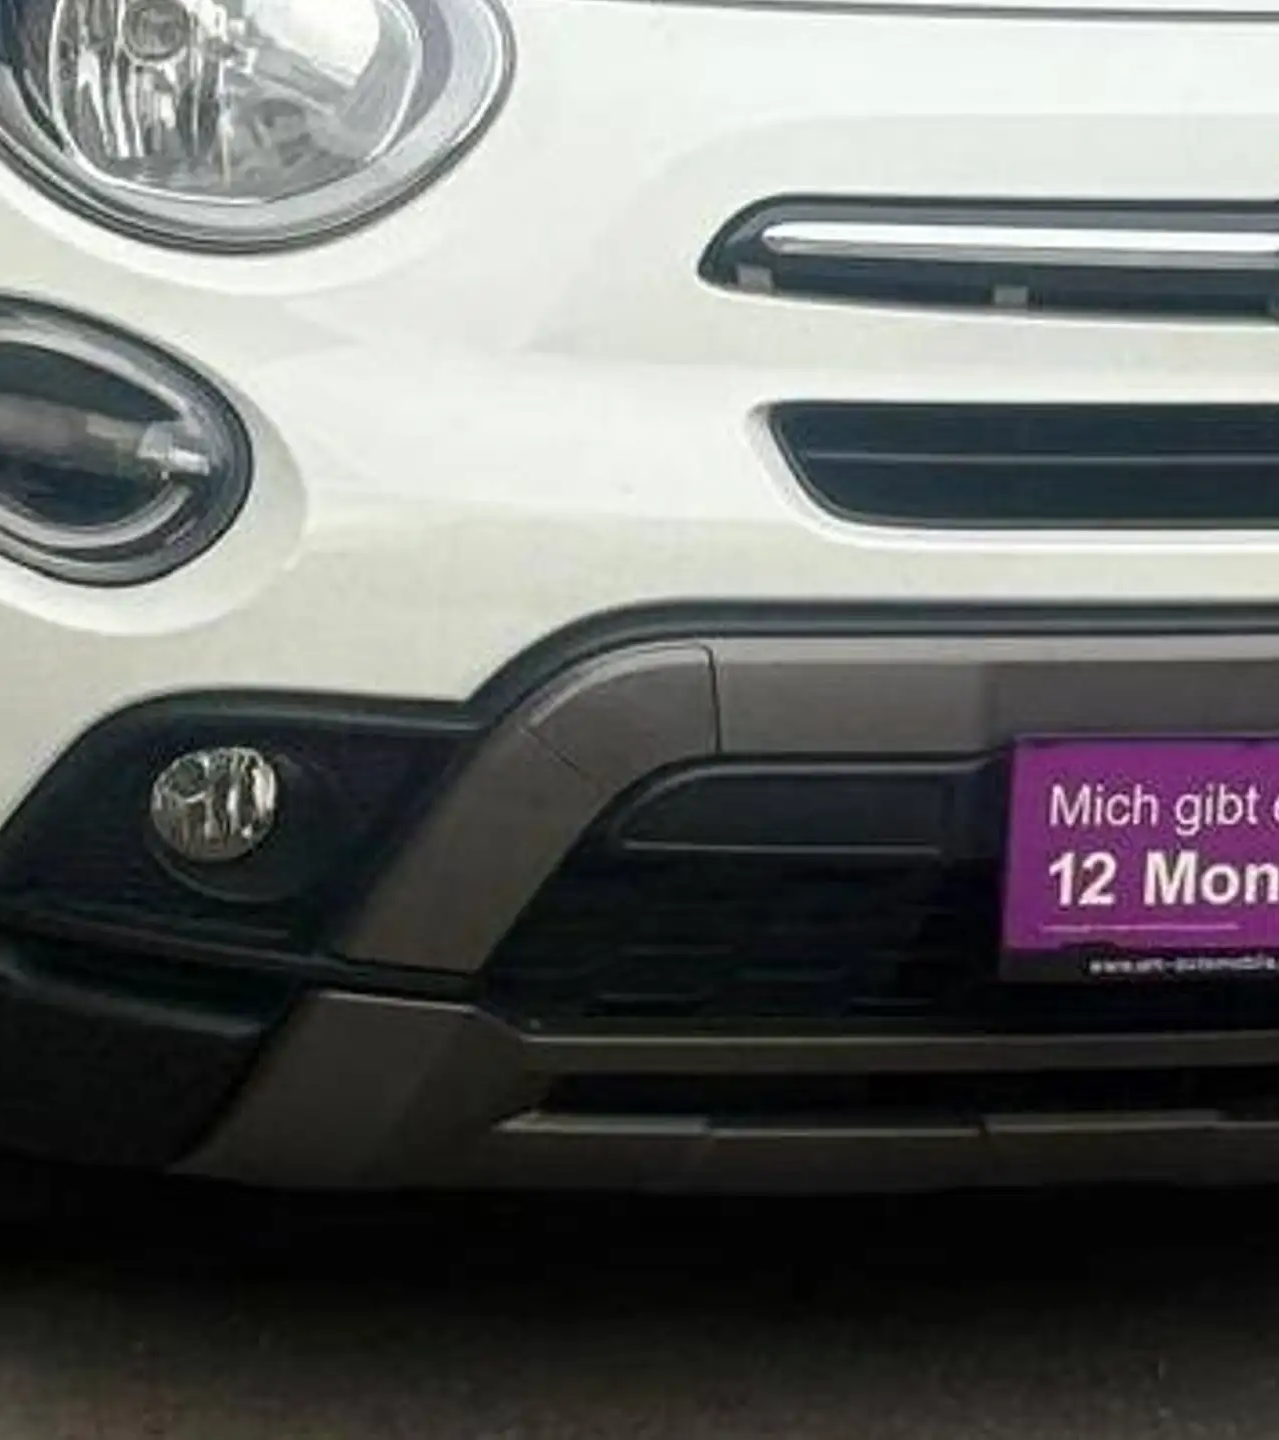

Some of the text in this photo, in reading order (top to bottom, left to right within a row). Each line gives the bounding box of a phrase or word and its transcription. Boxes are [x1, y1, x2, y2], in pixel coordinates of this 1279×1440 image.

[1048, 783, 1160, 827] Mich
[1174, 782, 1260, 836] gibt
[1048, 851, 1117, 906] 12
